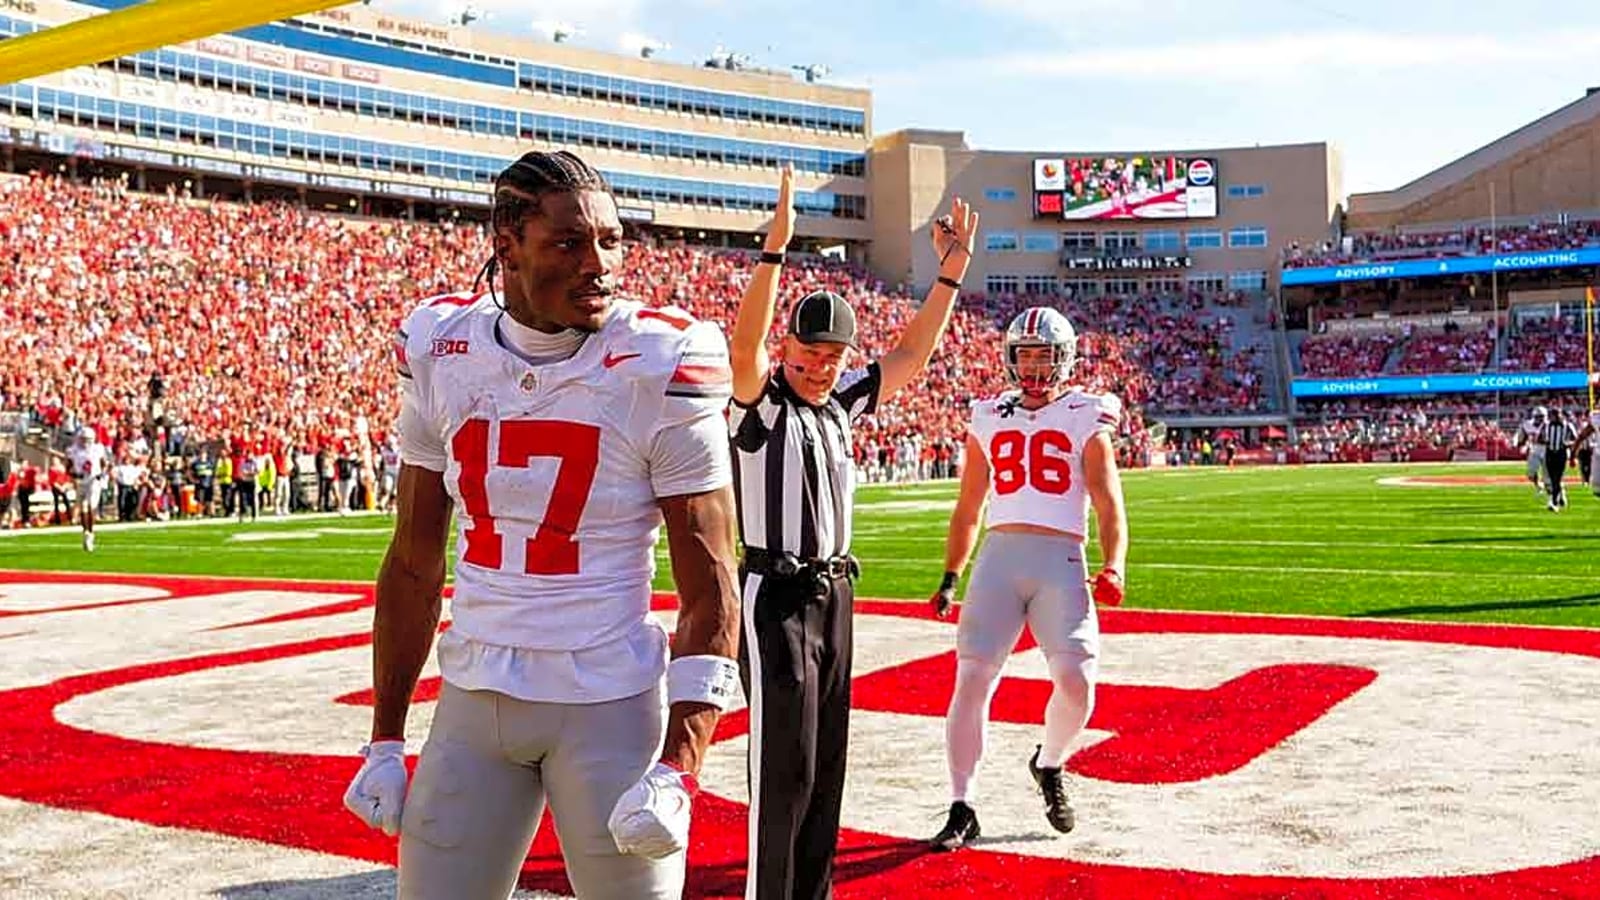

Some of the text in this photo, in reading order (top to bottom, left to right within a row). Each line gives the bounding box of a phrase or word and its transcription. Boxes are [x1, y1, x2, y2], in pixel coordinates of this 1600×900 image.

[1335, 266, 1395, 278] ADVISORY
[1494, 252, 1578, 267] ACCOUNTING
[1321, 381, 1379, 393] ADVISORY
[1472, 375, 1551, 387] ACCOUNTING
[990, 428, 1074, 496] 86
[451, 417, 601, 575] 17
